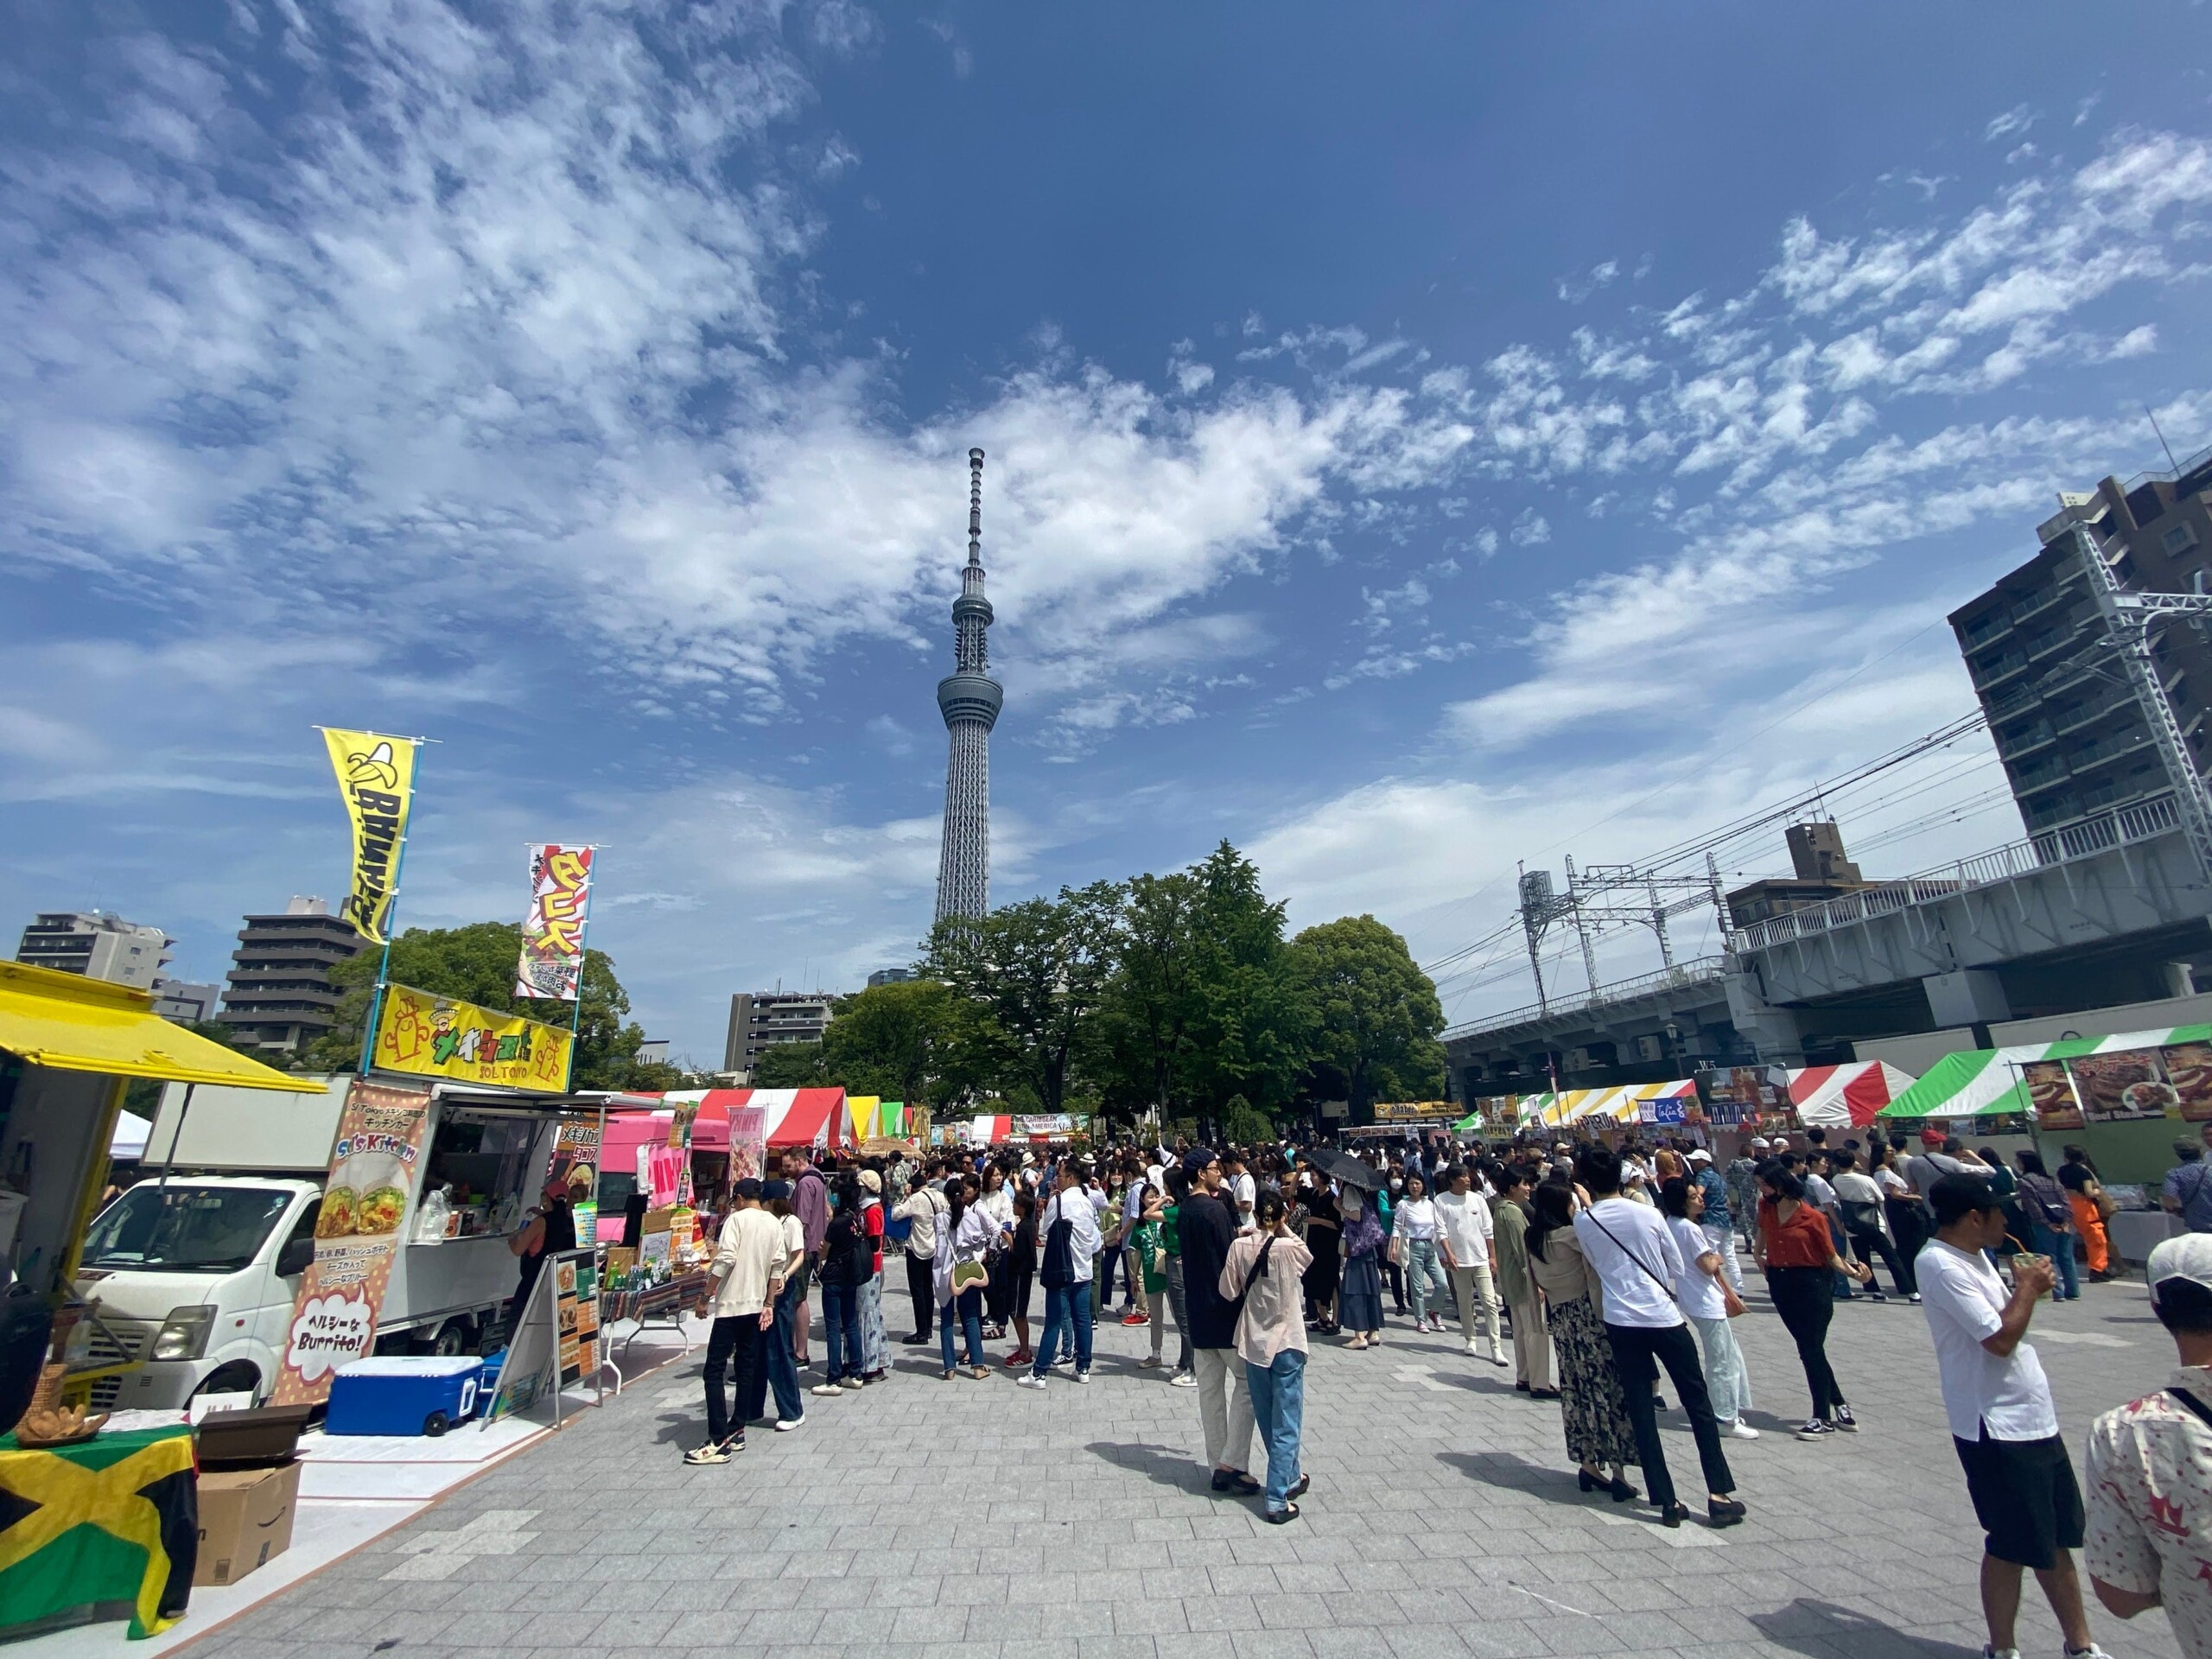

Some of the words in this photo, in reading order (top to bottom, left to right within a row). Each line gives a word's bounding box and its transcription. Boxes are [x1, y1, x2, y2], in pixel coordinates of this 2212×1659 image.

[479, 1065, 499, 1079] SOL
[2077, 1053, 2152, 1077] 牛ステーキ
[2088, 1110, 2112, 1121] Beef
[2114, 1109, 2145, 1120] Steak
[364, 1117, 410, 1129] キッチンカー
[1031, 1122, 1057, 1130] AMERICA
[366, 1134, 416, 1160] Kitchen
[308, 1315, 360, 1332] ヘルシーな
[297, 1332, 364, 1351] Burrito!
